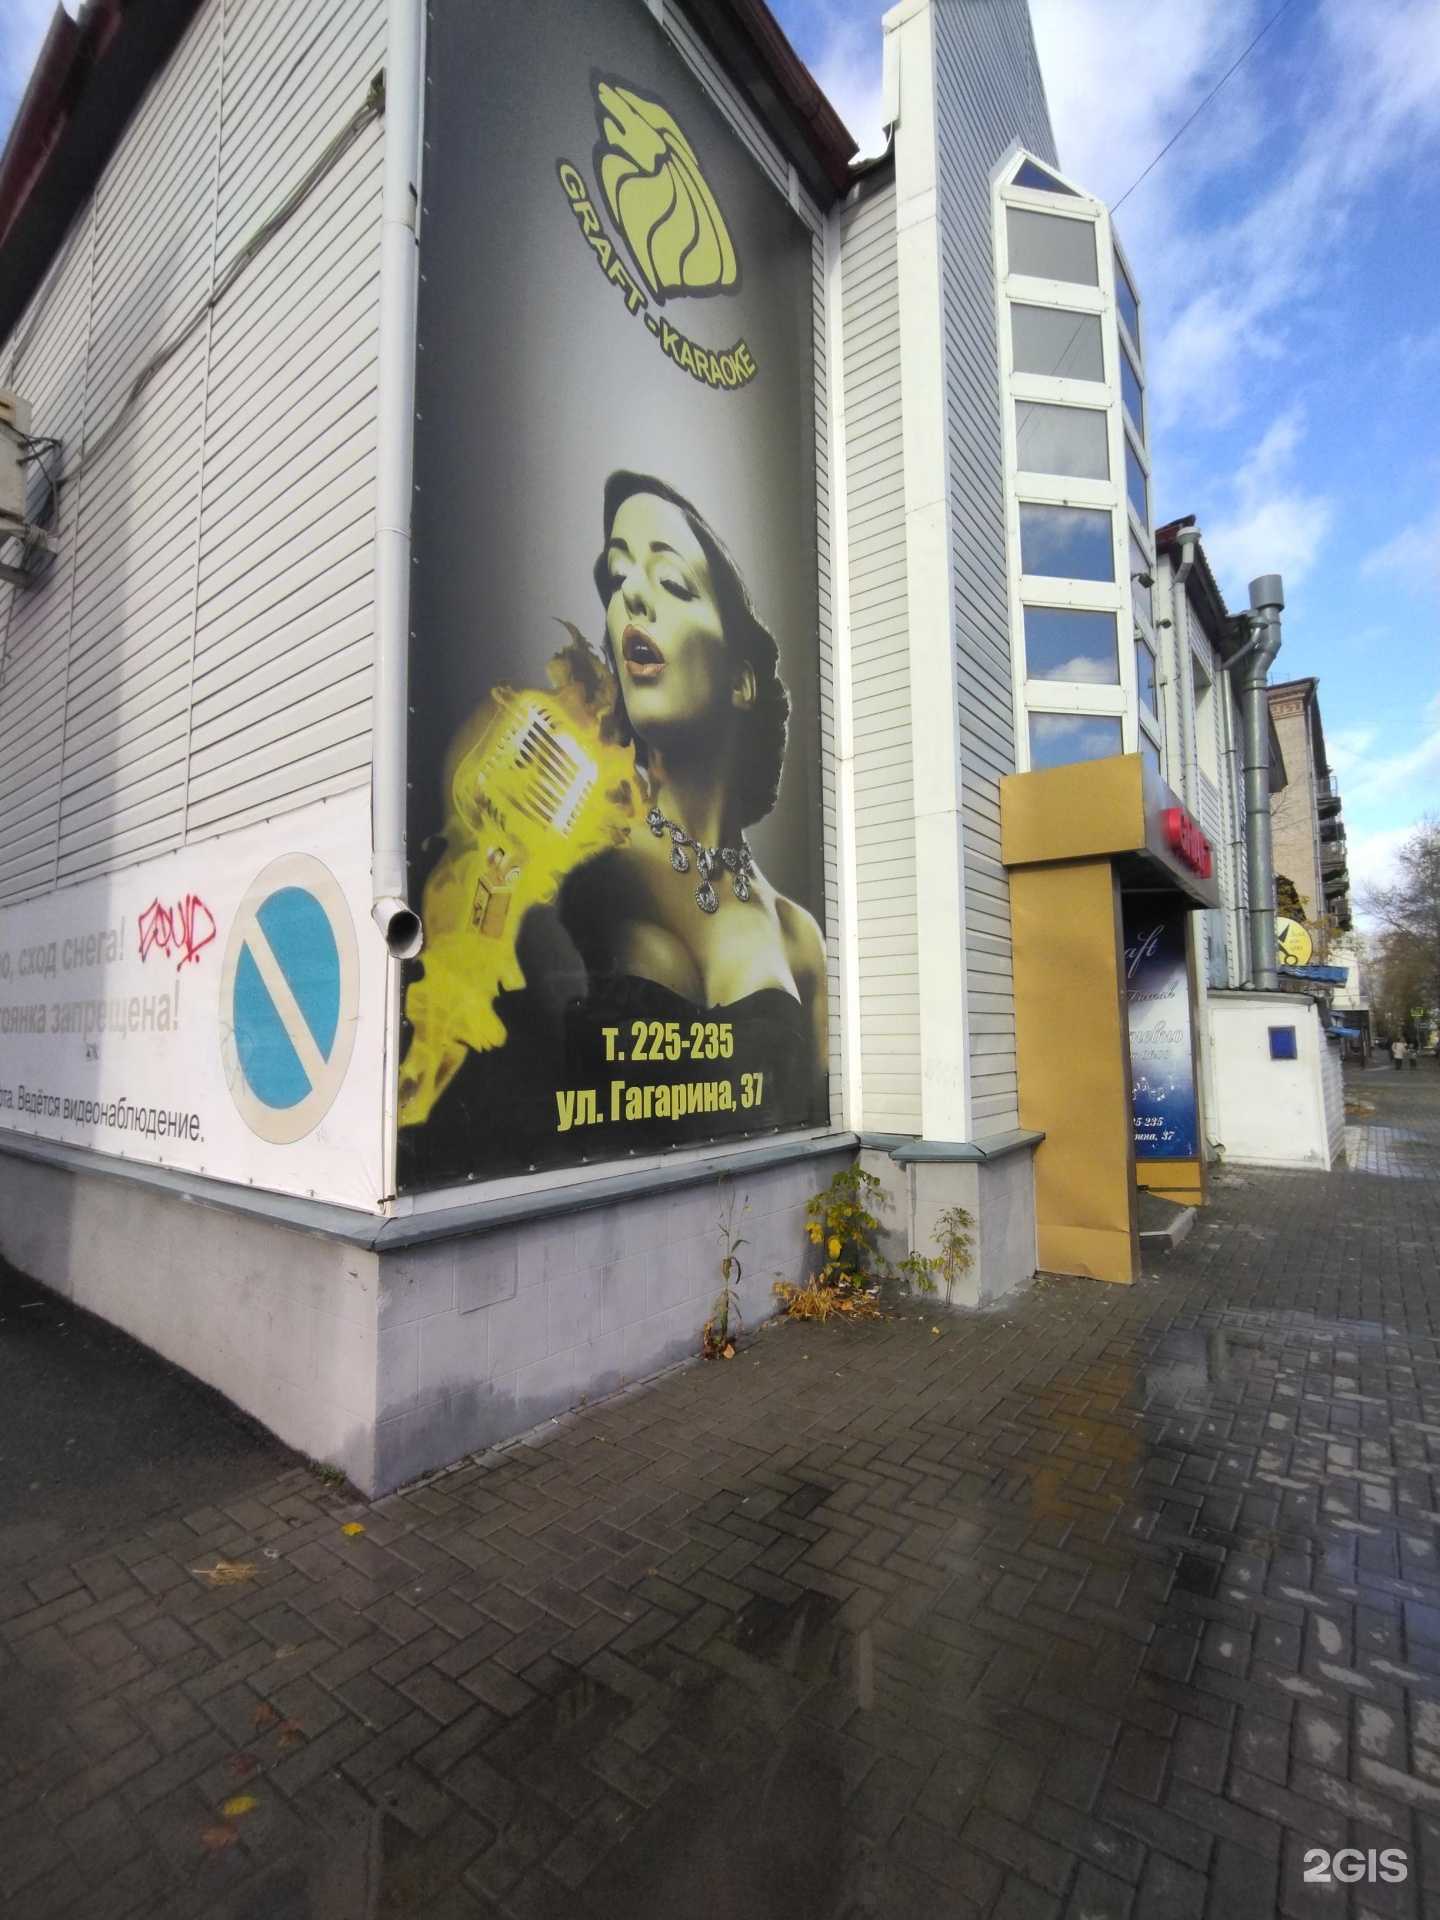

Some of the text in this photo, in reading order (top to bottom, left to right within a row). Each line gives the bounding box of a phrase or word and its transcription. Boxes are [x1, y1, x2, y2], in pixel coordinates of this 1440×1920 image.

[18, 942, 57, 980] сход
[62, 916, 125, 970] снега!
[50, 980, 180, 1042] запрещена!
[631, 1021, 734, 1061] 225-235
[18, 1084, 61, 1119] Ведётся
[63, 1098, 205, 1142] видеонаблюдение.
[556, 1072, 764, 1131] ул. Гагарина, 37
